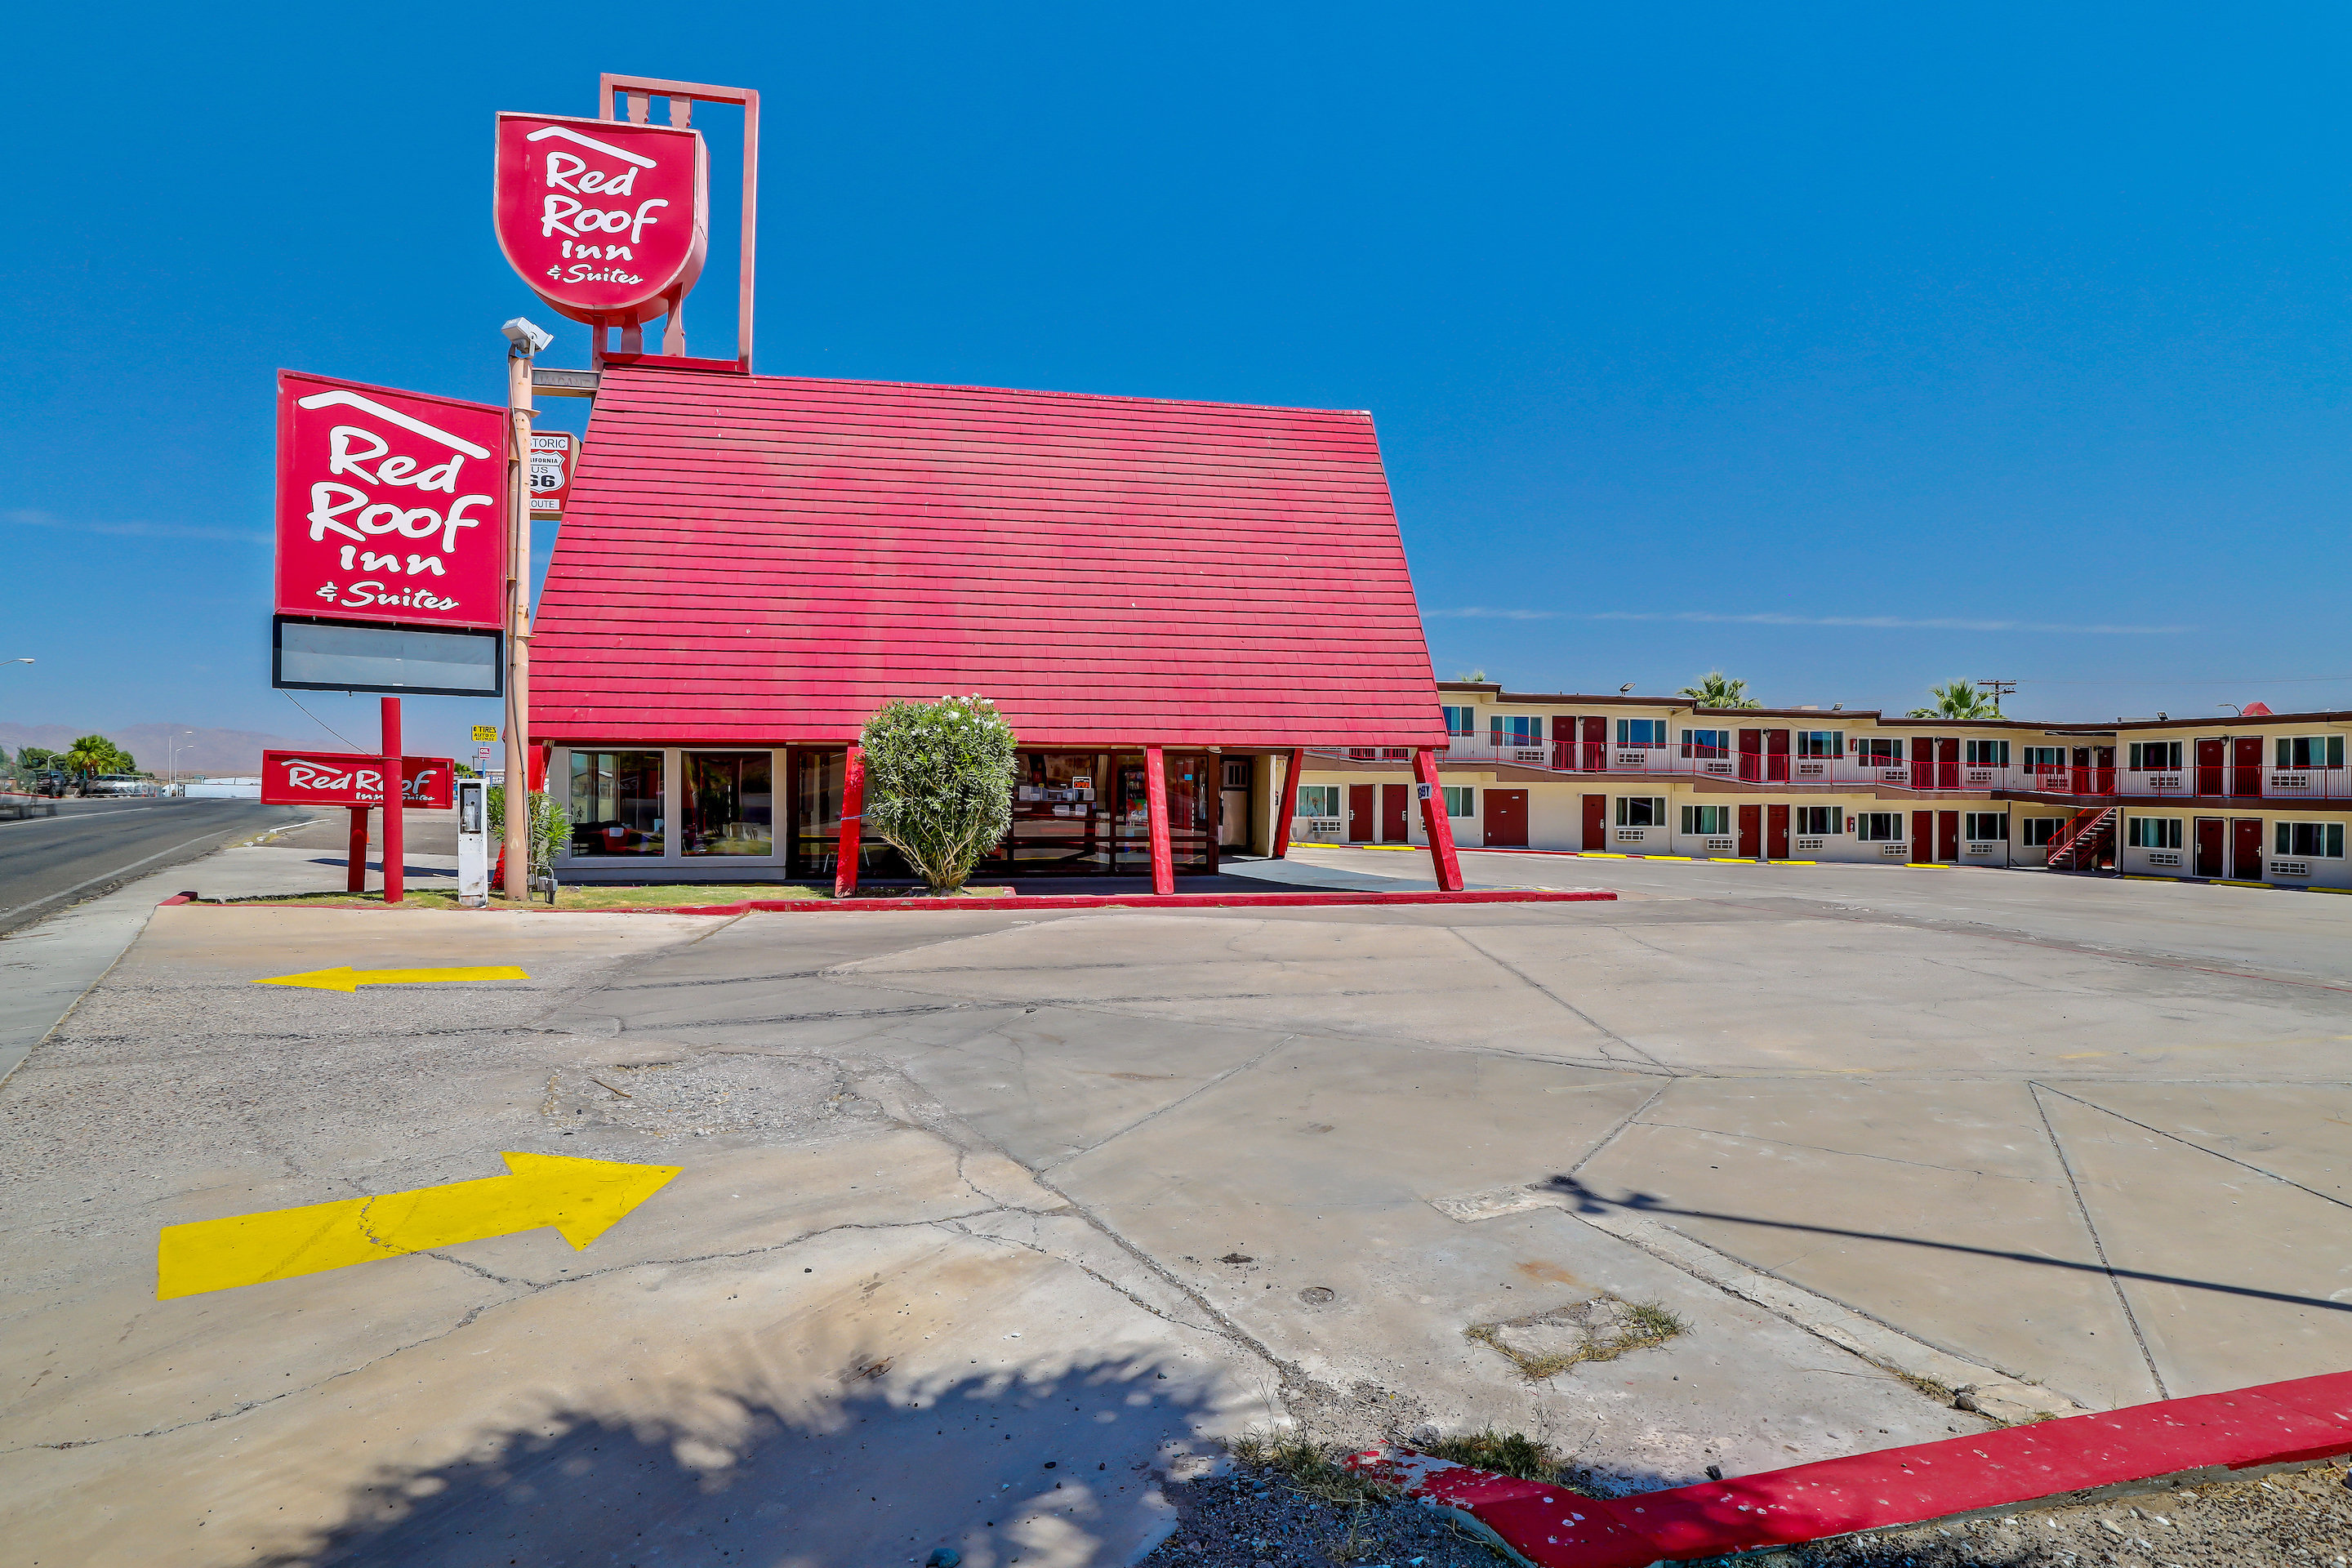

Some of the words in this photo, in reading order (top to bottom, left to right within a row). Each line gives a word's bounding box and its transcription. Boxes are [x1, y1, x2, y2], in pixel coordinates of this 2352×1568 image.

[546, 151, 639, 197] Red
[540, 194, 669, 244] Roof
[561, 239, 634, 261] Inn
[546, 264, 562, 280] &
[563, 263, 644, 285] Suites
[531, 438, 566, 448] TORIC
[329, 425, 466, 494] Red
[306, 481, 494, 554] Roof
[531, 500, 555, 509] OUTE
[340, 545, 446, 577] Inn
[316, 581, 338, 603] &
[341, 581, 460, 611] Suites
[288, 766, 353, 790] Red
[1418, 786, 1430, 799] BBY
